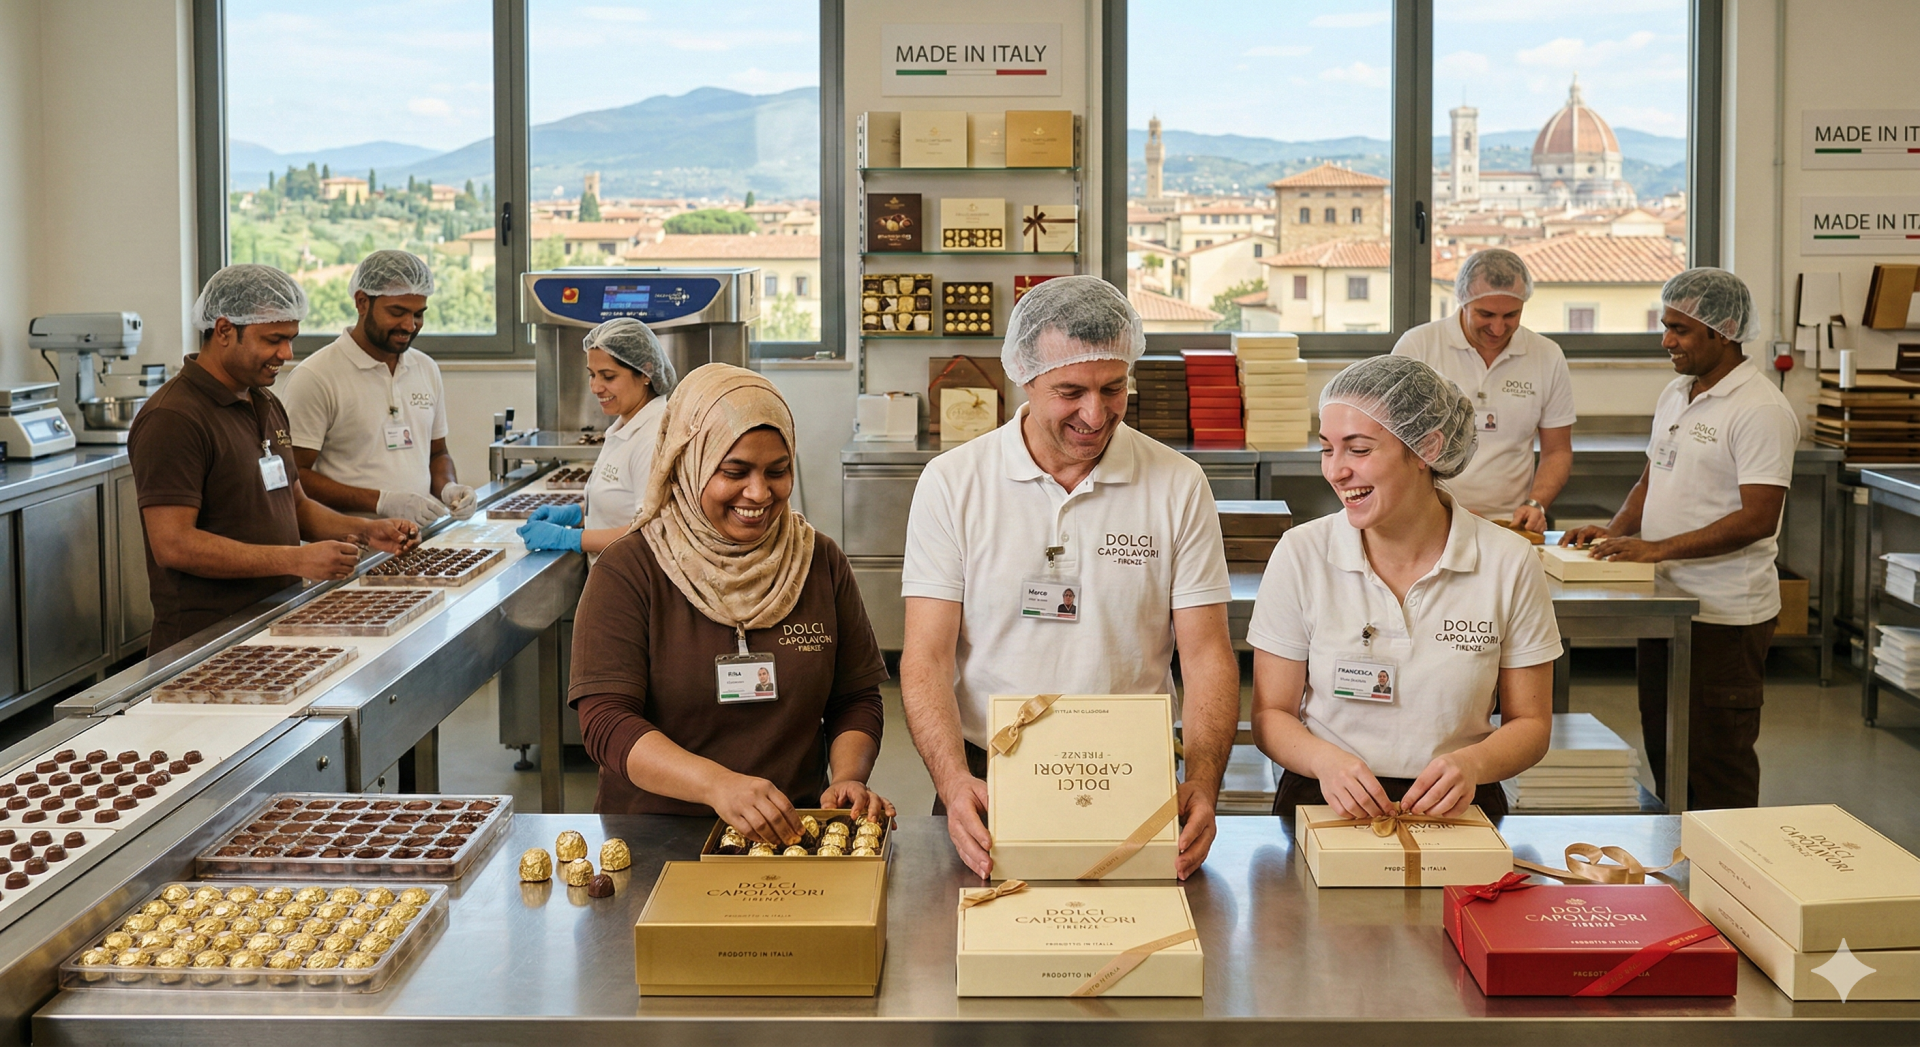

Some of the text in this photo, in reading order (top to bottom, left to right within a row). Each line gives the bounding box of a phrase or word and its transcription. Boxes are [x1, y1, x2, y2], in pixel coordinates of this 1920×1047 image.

[896, 45, 1047, 62] MADE IN ITALY
[1815, 126, 1872, 142] MADE
[1878, 126, 1898, 142] IN
[1813, 214, 1920, 230] MADE IN IT
[1505, 380, 1532, 390] DOLCI
[1106, 534, 1153, 548] DOLCI
[1097, 547, 1159, 558] CAPOLAVORI
[783, 622, 825, 636] DOLCI
[1443, 620, 1493, 634] DOLCI
[1435, 633, 1499, 644] CAPOLAVORI
[1034, 763, 1133, 775] CAPOLAORI
[1058, 779, 1110, 790] DOLCI
[1810, 834, 1855, 859] DOLCI
[1046, 908, 1104, 916] DOLCI
[1551, 906, 1612, 914] DOLCI
[1015, 916, 1136, 924] CAPOLAVORI
[1524, 914, 1648, 922] CAPOLAVORI
